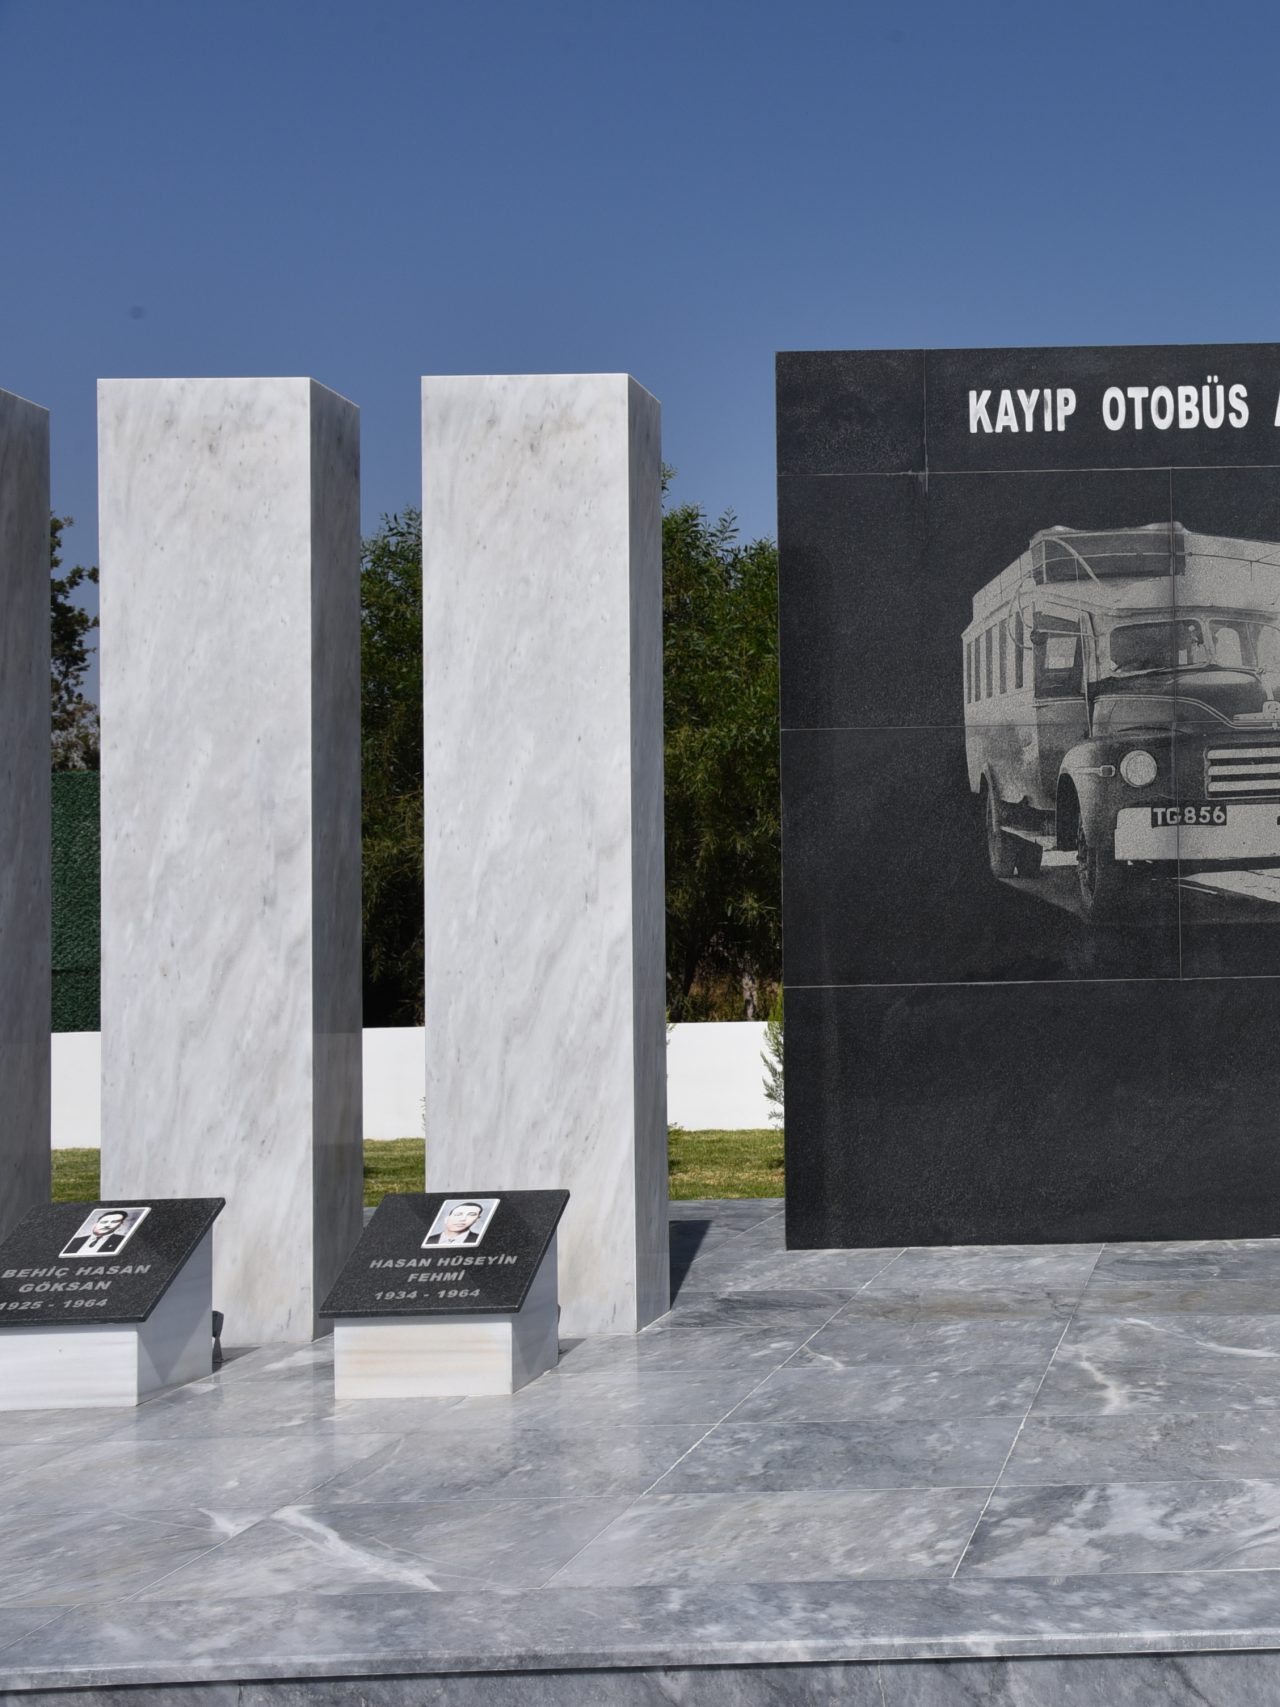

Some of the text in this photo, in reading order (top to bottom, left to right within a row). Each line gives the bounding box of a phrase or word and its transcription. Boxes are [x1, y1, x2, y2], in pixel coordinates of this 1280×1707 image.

[968, 388, 1077, 434] KAYIP
[1102, 375, 1250, 431] OTOBÜS
[369, 1254, 518, 1269] HASAN HÜSEYİN
[1, 1264, 151, 1279] BEHİÇ HASAN
[407, 1270, 466, 1283] FEHMİ
[18, 1280, 112, 1293] GÖKSAN
[374, 1291, 418, 1301] 1934
[437, 1289, 481, 1299] 1964
[0, 1301, 43, 1311] 1925
[63, 1299, 108, 1309] 1964
